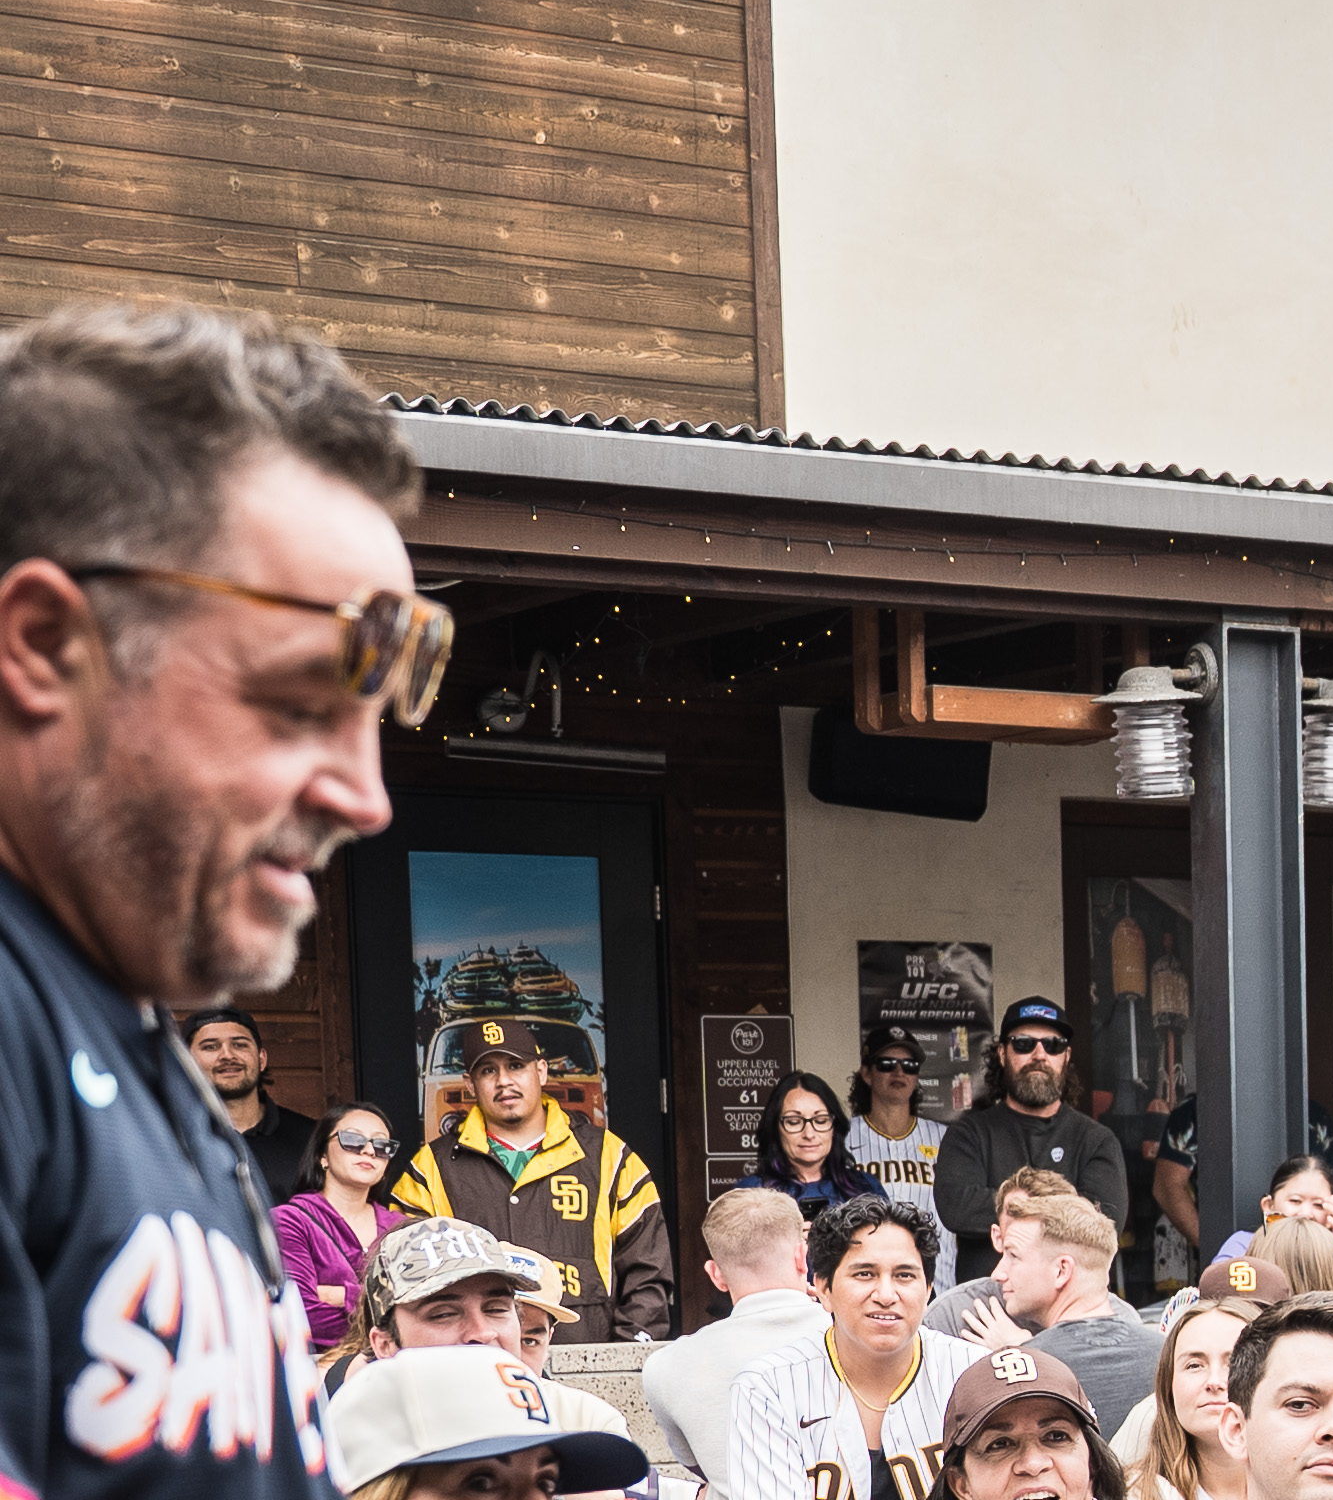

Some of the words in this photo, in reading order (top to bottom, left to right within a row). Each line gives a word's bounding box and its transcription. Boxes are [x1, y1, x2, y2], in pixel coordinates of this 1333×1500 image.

[906, 966, 925, 978] 101
[900, 982, 960, 1000] UFC
[880, 1009, 917, 1019] DRINK
[919, 1009, 976, 1020] SPECIALS
[483, 1021, 504, 1045] SD
[735, 1028, 759, 1039] Park
[742, 1038, 754, 1047] 101
[717, 1059, 749, 1069] UPPER
[751, 1059, 780, 1069] LEVEL
[723, 1068, 774, 1078] MAXIMUM
[717, 1077, 780, 1087] OCCUPANCY
[739, 1090, 758, 1104] 61
[725, 1112, 761, 1122] OUTDO
[729, 1121, 759, 1131] SEATI
[550, 1174, 589, 1222] SD
[1229, 1260, 1257, 1292] SD
[990, 1348, 1038, 1385] SD
[496, 1362, 550, 1424] SD
